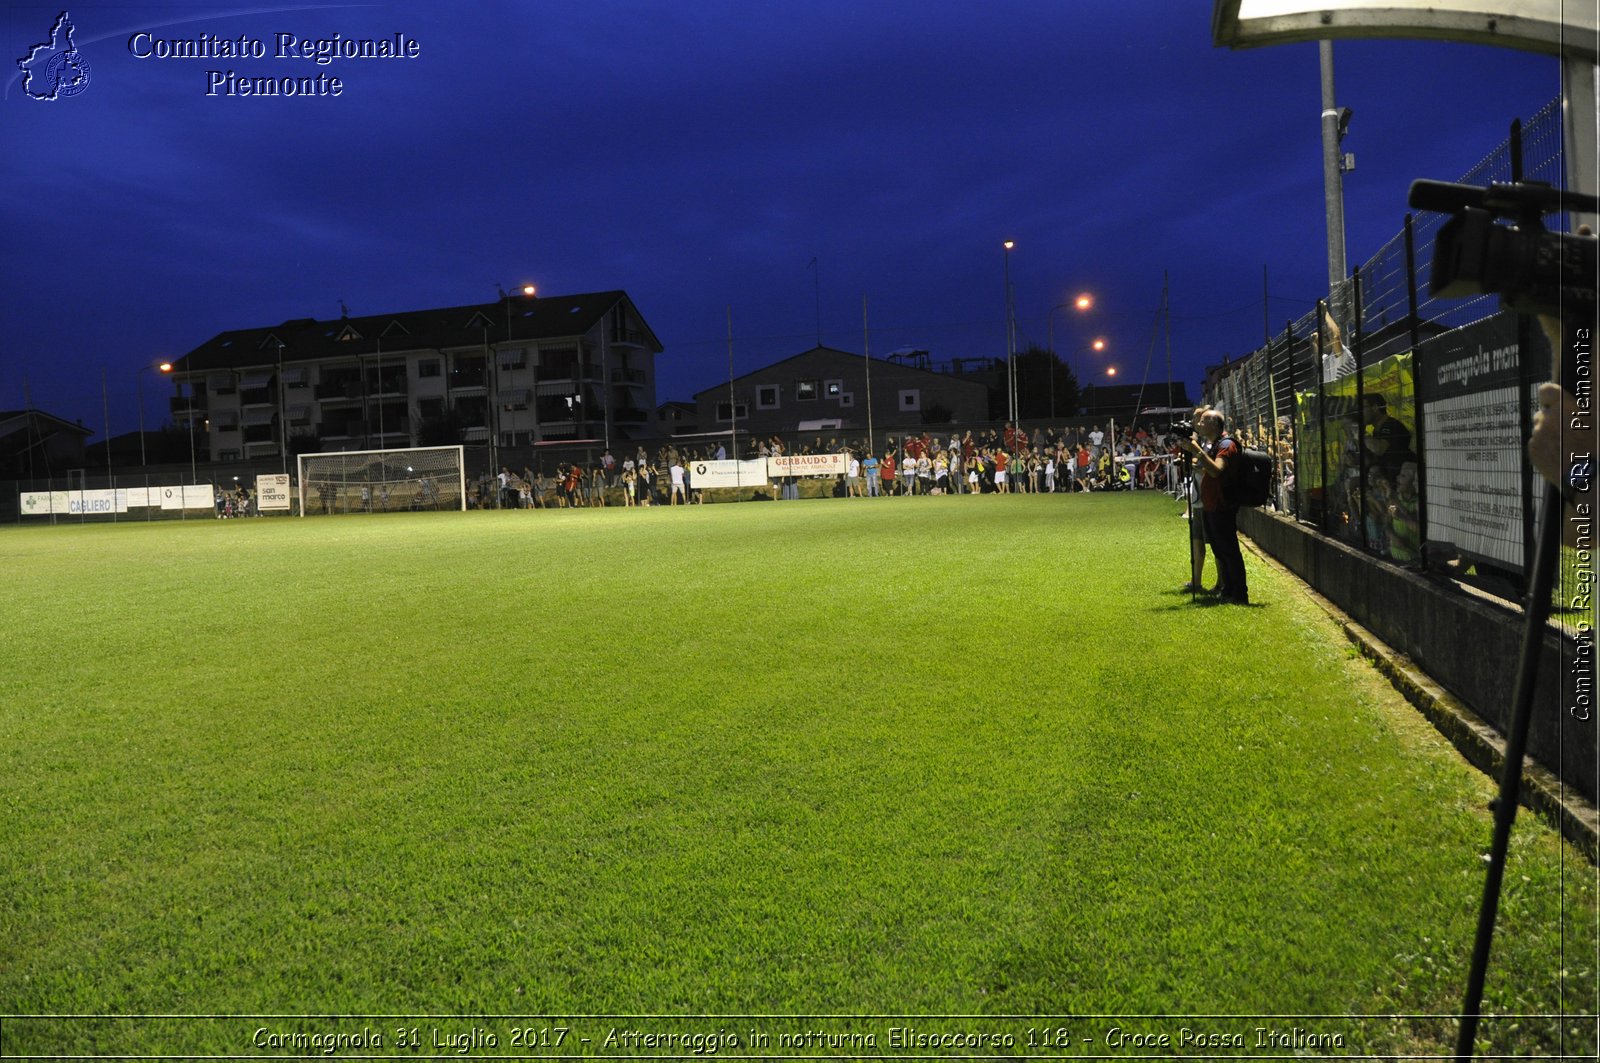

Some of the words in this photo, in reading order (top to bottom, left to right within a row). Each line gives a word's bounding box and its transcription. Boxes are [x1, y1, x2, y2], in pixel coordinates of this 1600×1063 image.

[1437, 343, 1490, 387] carmagnola
[775, 456, 828, 466] GERBAUDO
[71, 499, 110, 512] CAGLIERO
